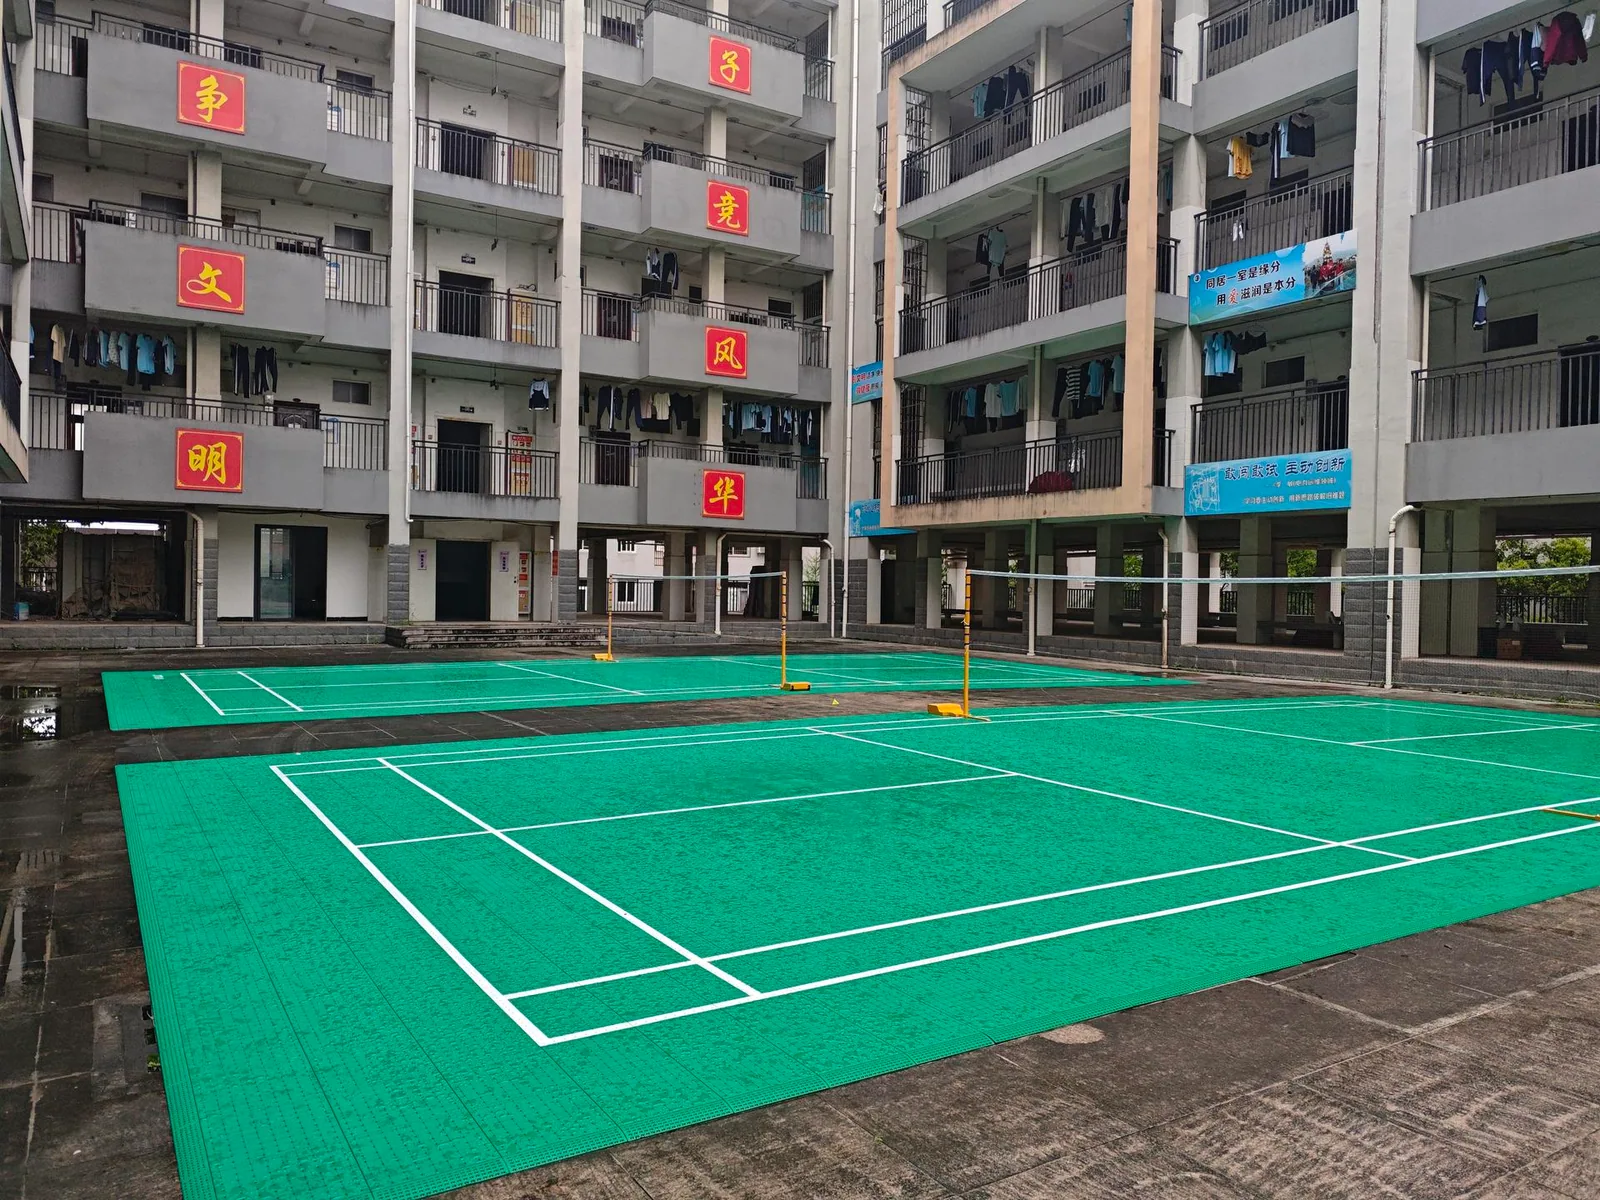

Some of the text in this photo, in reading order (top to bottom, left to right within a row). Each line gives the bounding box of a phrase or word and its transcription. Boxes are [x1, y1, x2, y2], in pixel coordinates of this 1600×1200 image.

[719, 49, 741, 85] 子
[195, 75, 229, 123] 争
[713, 190, 741, 231] 竞
[187, 262, 232, 303] 文
[1206, 261, 1281, 289] 同居一室是缘分
[1216, 277, 1297, 305] 用爱滋润是本分
[714, 337, 742, 369] 风
[188, 441, 227, 485] 明
[1224, 457, 1346, 480] 敢闯敢试 主动创新
[710, 477, 738, 513] 华
